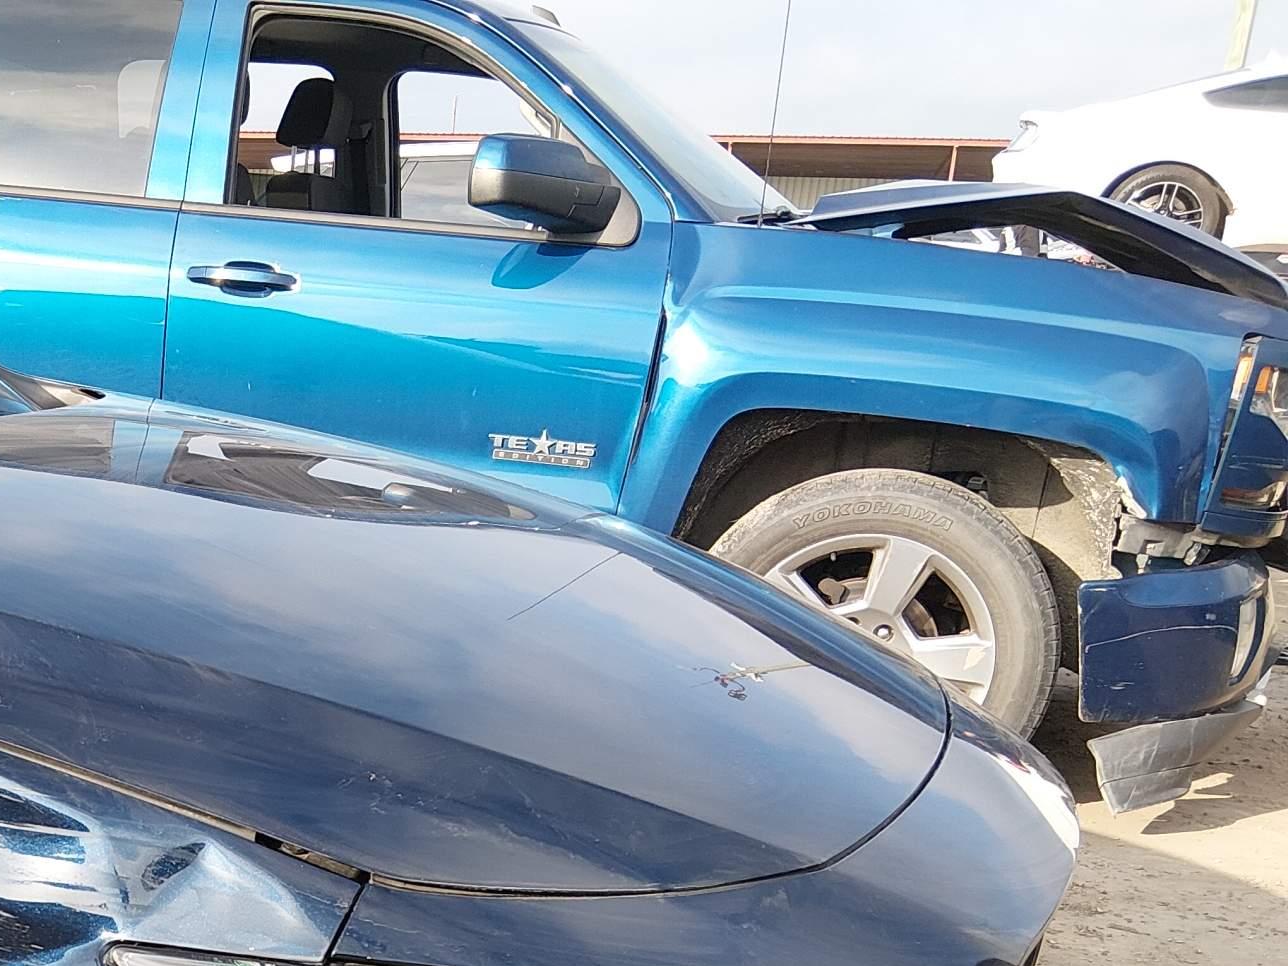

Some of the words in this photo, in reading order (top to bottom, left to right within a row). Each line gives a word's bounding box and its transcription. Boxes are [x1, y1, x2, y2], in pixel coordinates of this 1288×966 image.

[488, 429, 597, 457] TEXAS
[497, 451, 586, 466] EDITION
[792, 500, 954, 531] YOKOHAMA
